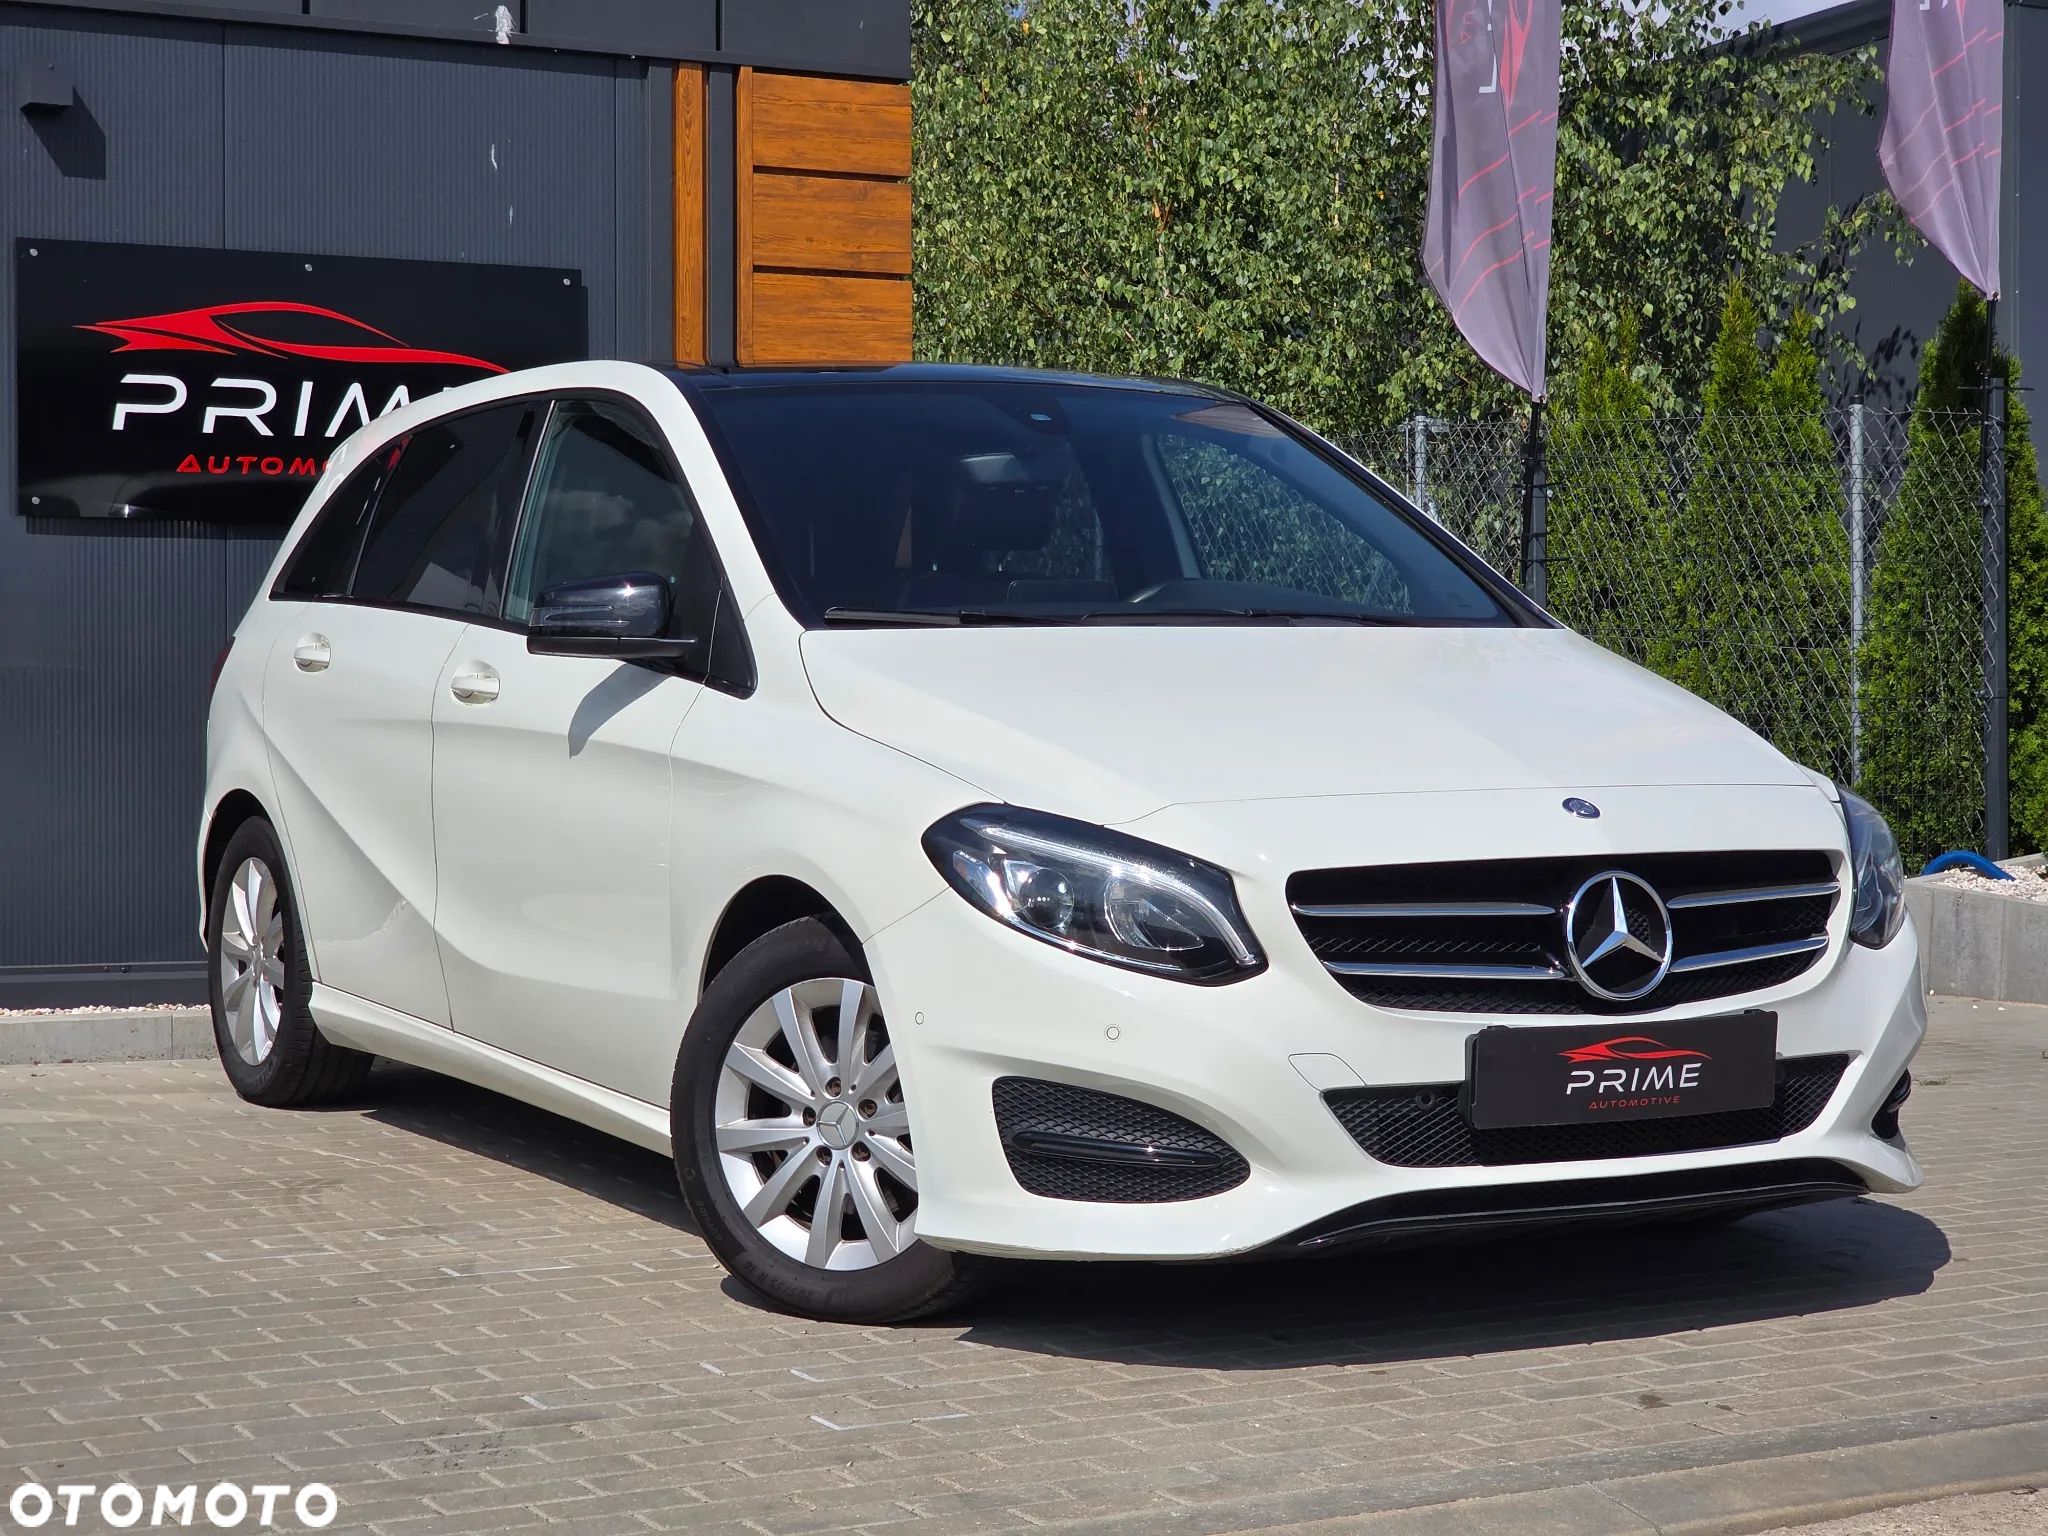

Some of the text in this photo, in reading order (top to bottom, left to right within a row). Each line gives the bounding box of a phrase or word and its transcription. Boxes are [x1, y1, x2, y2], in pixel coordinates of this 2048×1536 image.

[111, 373, 455, 438] PRIM
[1566, 1062, 1702, 1095] PRIME
[1588, 1096, 1680, 1109] AUTOMOTIVE
